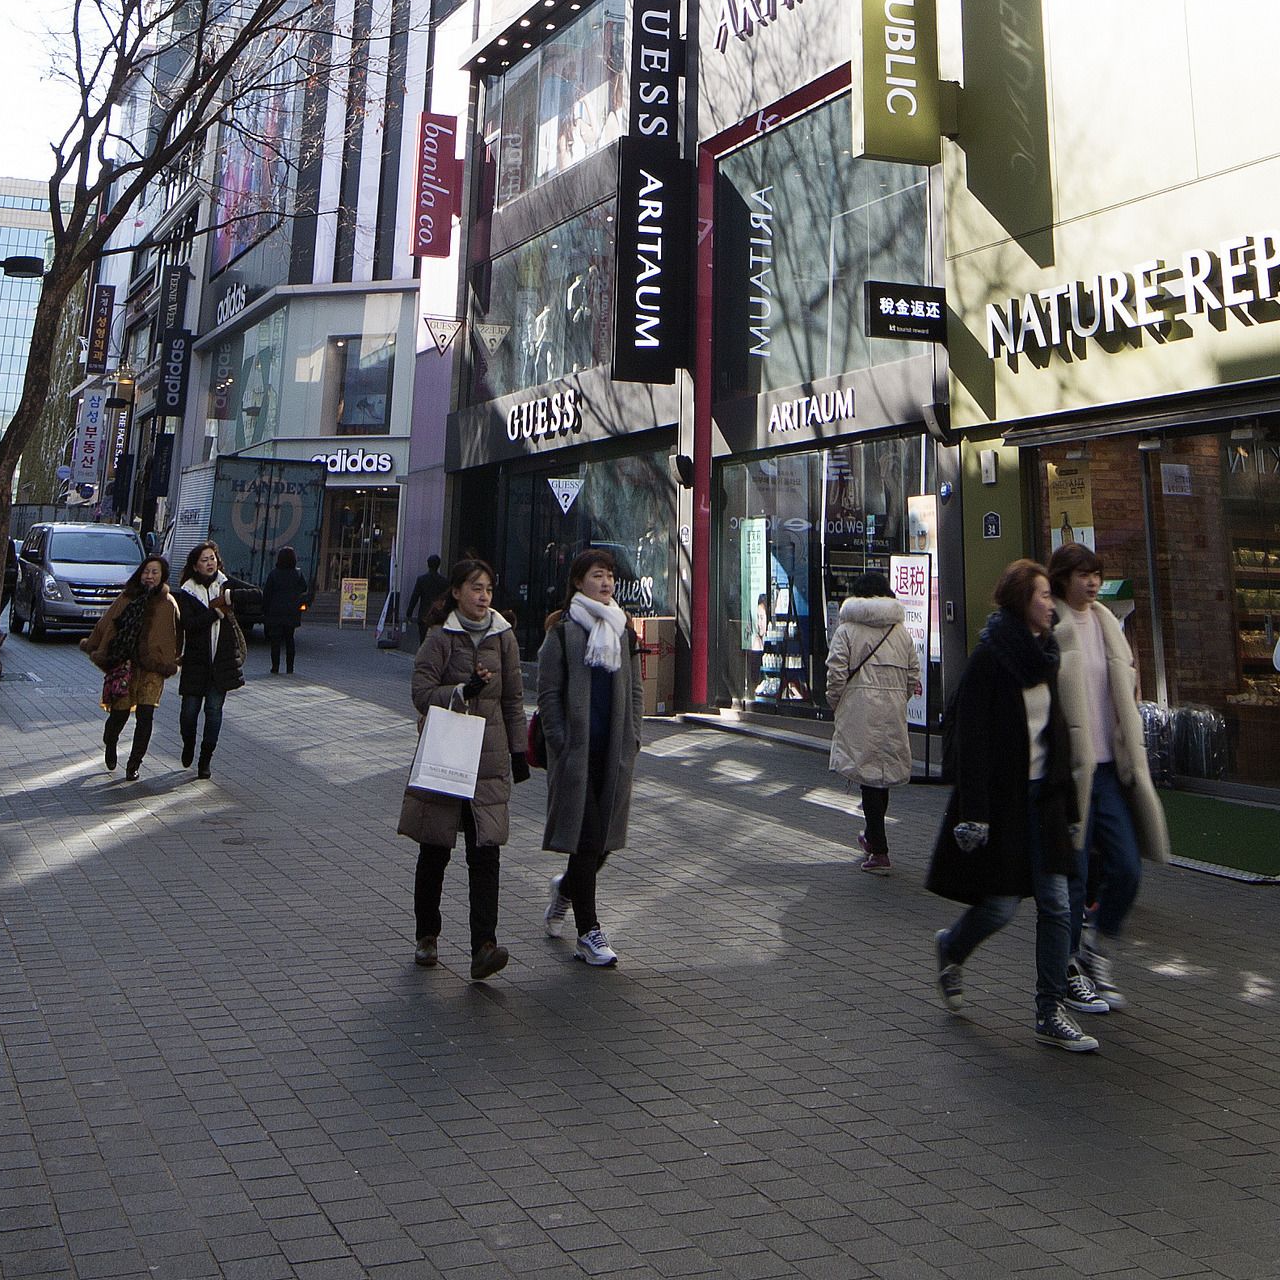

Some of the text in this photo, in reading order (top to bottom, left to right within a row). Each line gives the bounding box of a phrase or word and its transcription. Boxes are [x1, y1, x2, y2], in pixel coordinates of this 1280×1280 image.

[418, 122, 452, 247] banila co.
[634, 168, 665, 349] ARITAUM
[216, 283, 247, 326] adidas
[429, 321, 457, 331] GUESS
[879, 296, 941, 319] 税金返还
[986, 260, 1165, 360] NATURE
[166, 337, 185, 406] adidas
[506, 388, 578, 441] GUESS
[767, 387, 856, 434] ARITAUM
[551, 480, 580, 489] GUESS
[987, 524, 996, 536] 34
[895, 565, 925, 597] 退税
